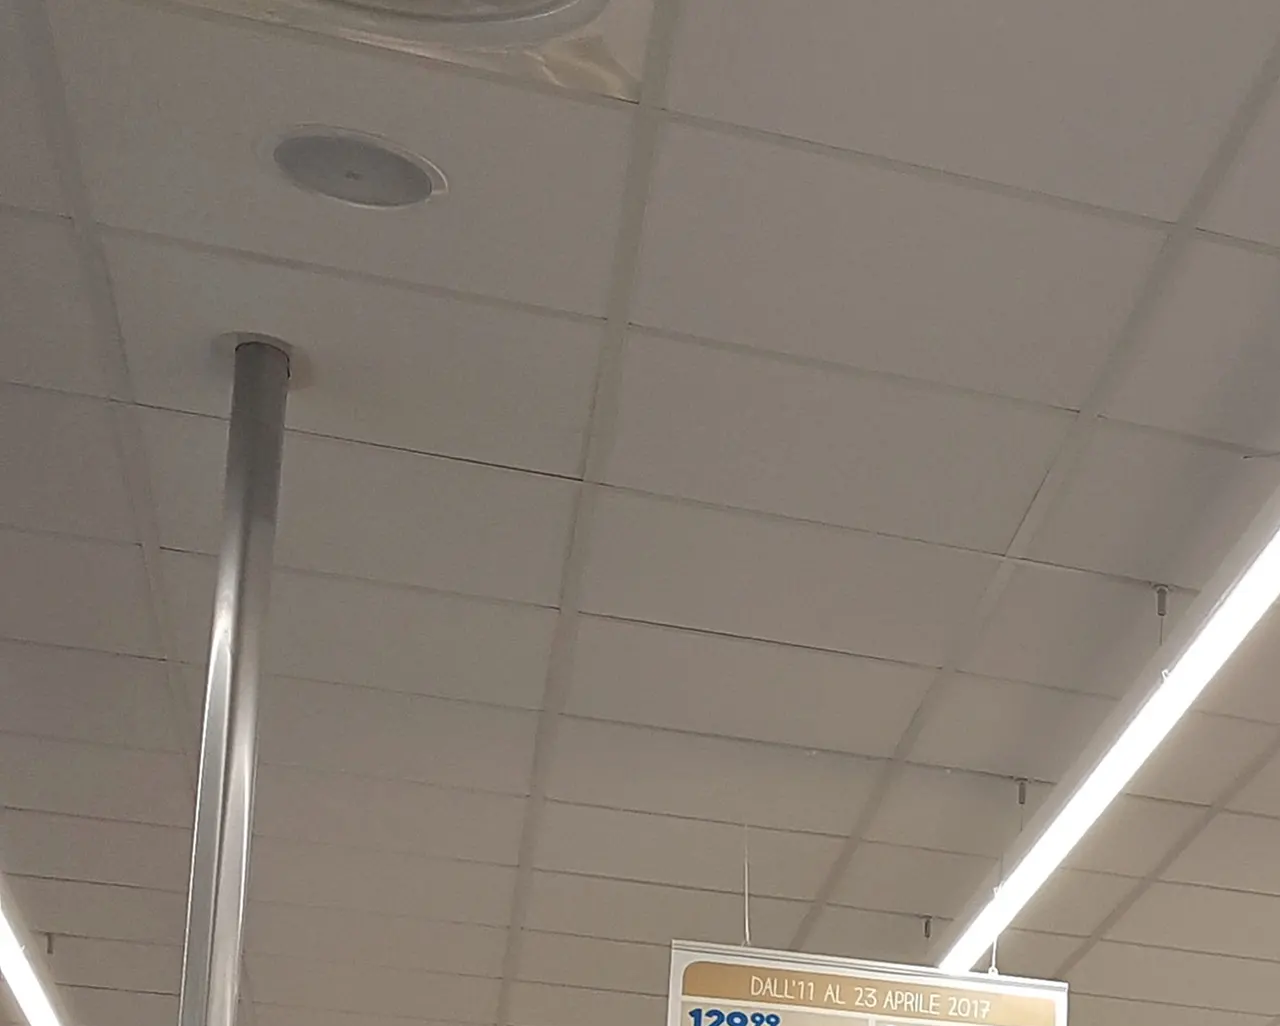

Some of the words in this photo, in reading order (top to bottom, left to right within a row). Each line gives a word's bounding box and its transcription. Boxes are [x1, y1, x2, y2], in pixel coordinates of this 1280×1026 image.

[751, 976, 814, 1000] DALL'11
[824, 984, 845, 1004] AL
[854, 987, 877, 1007] 23
[883, 991, 941, 1015] APRILE
[948, 997, 990, 1019] 2017
